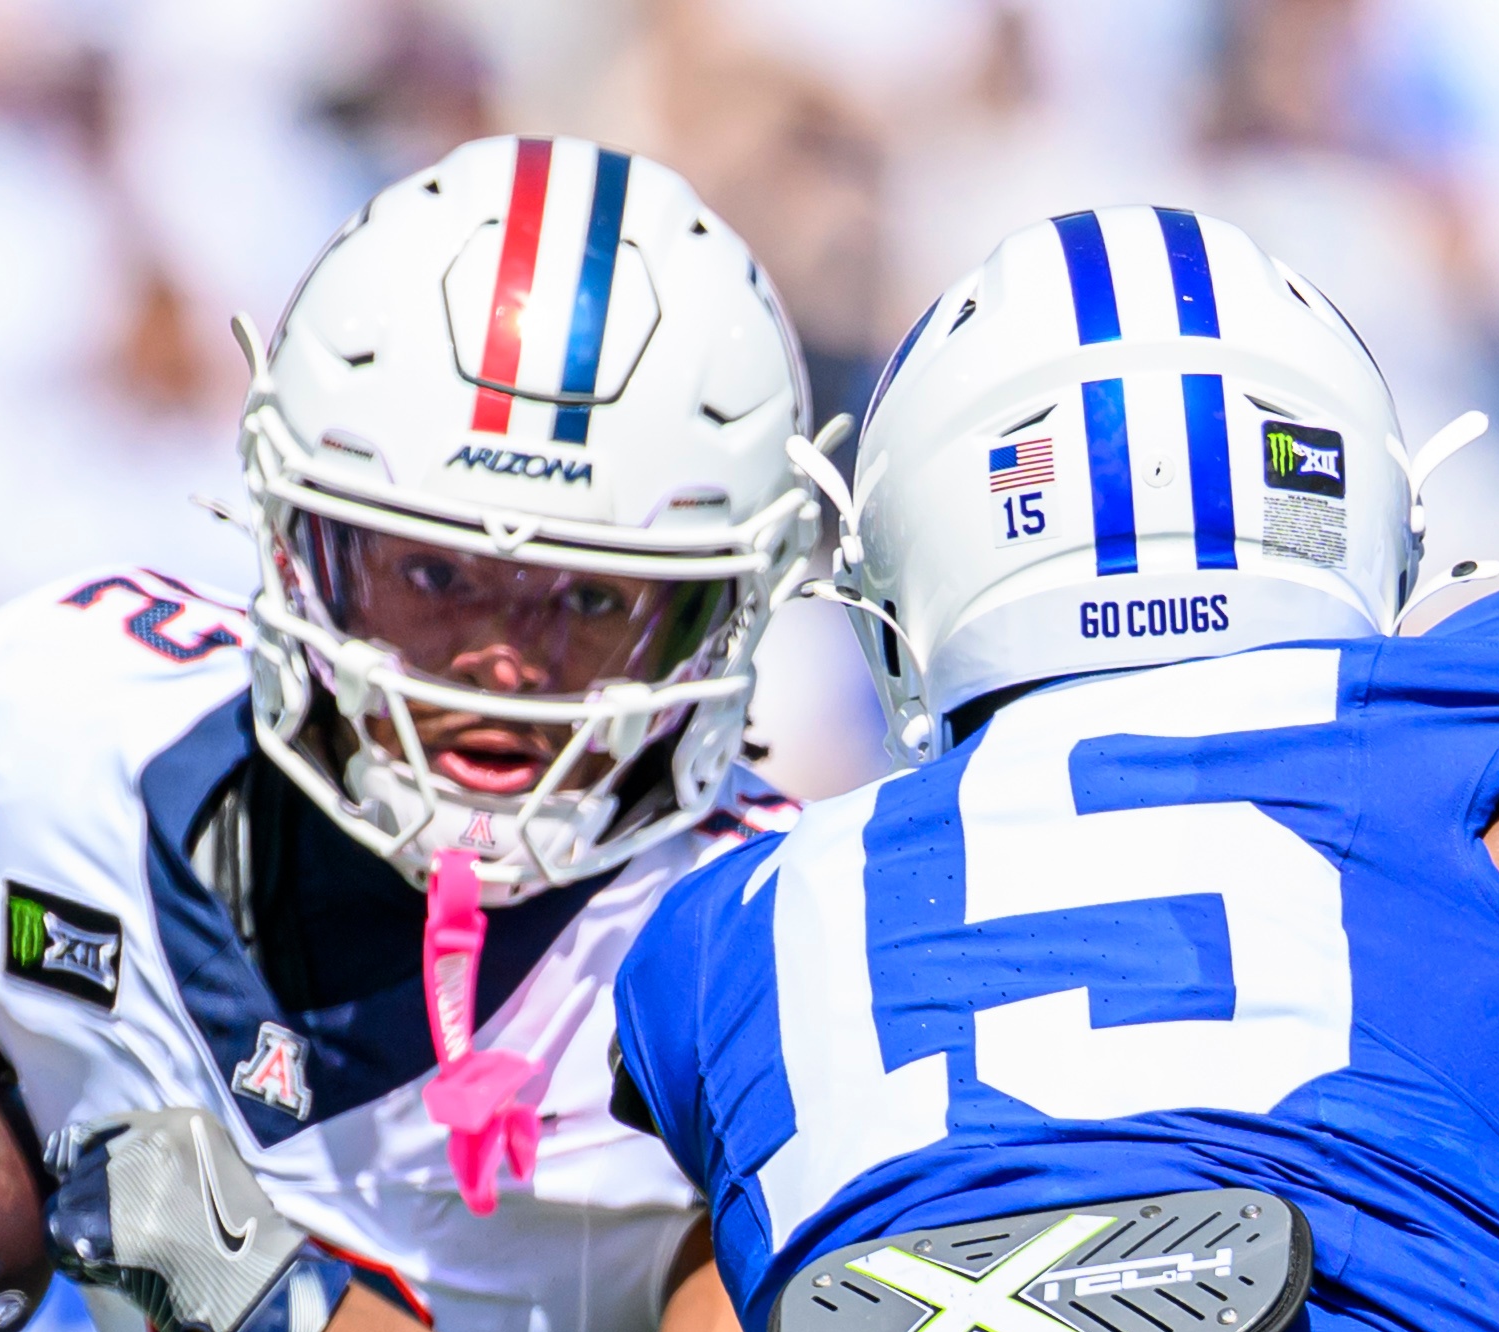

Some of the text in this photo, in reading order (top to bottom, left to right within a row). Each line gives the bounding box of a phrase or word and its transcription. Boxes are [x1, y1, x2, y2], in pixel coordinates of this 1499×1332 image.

[444, 445, 593, 488] ARIZONA
[1003, 491, 1046, 539] 15
[1080, 594, 1229, 638] GO COUGS
[741, 647, 1353, 1255] 15
